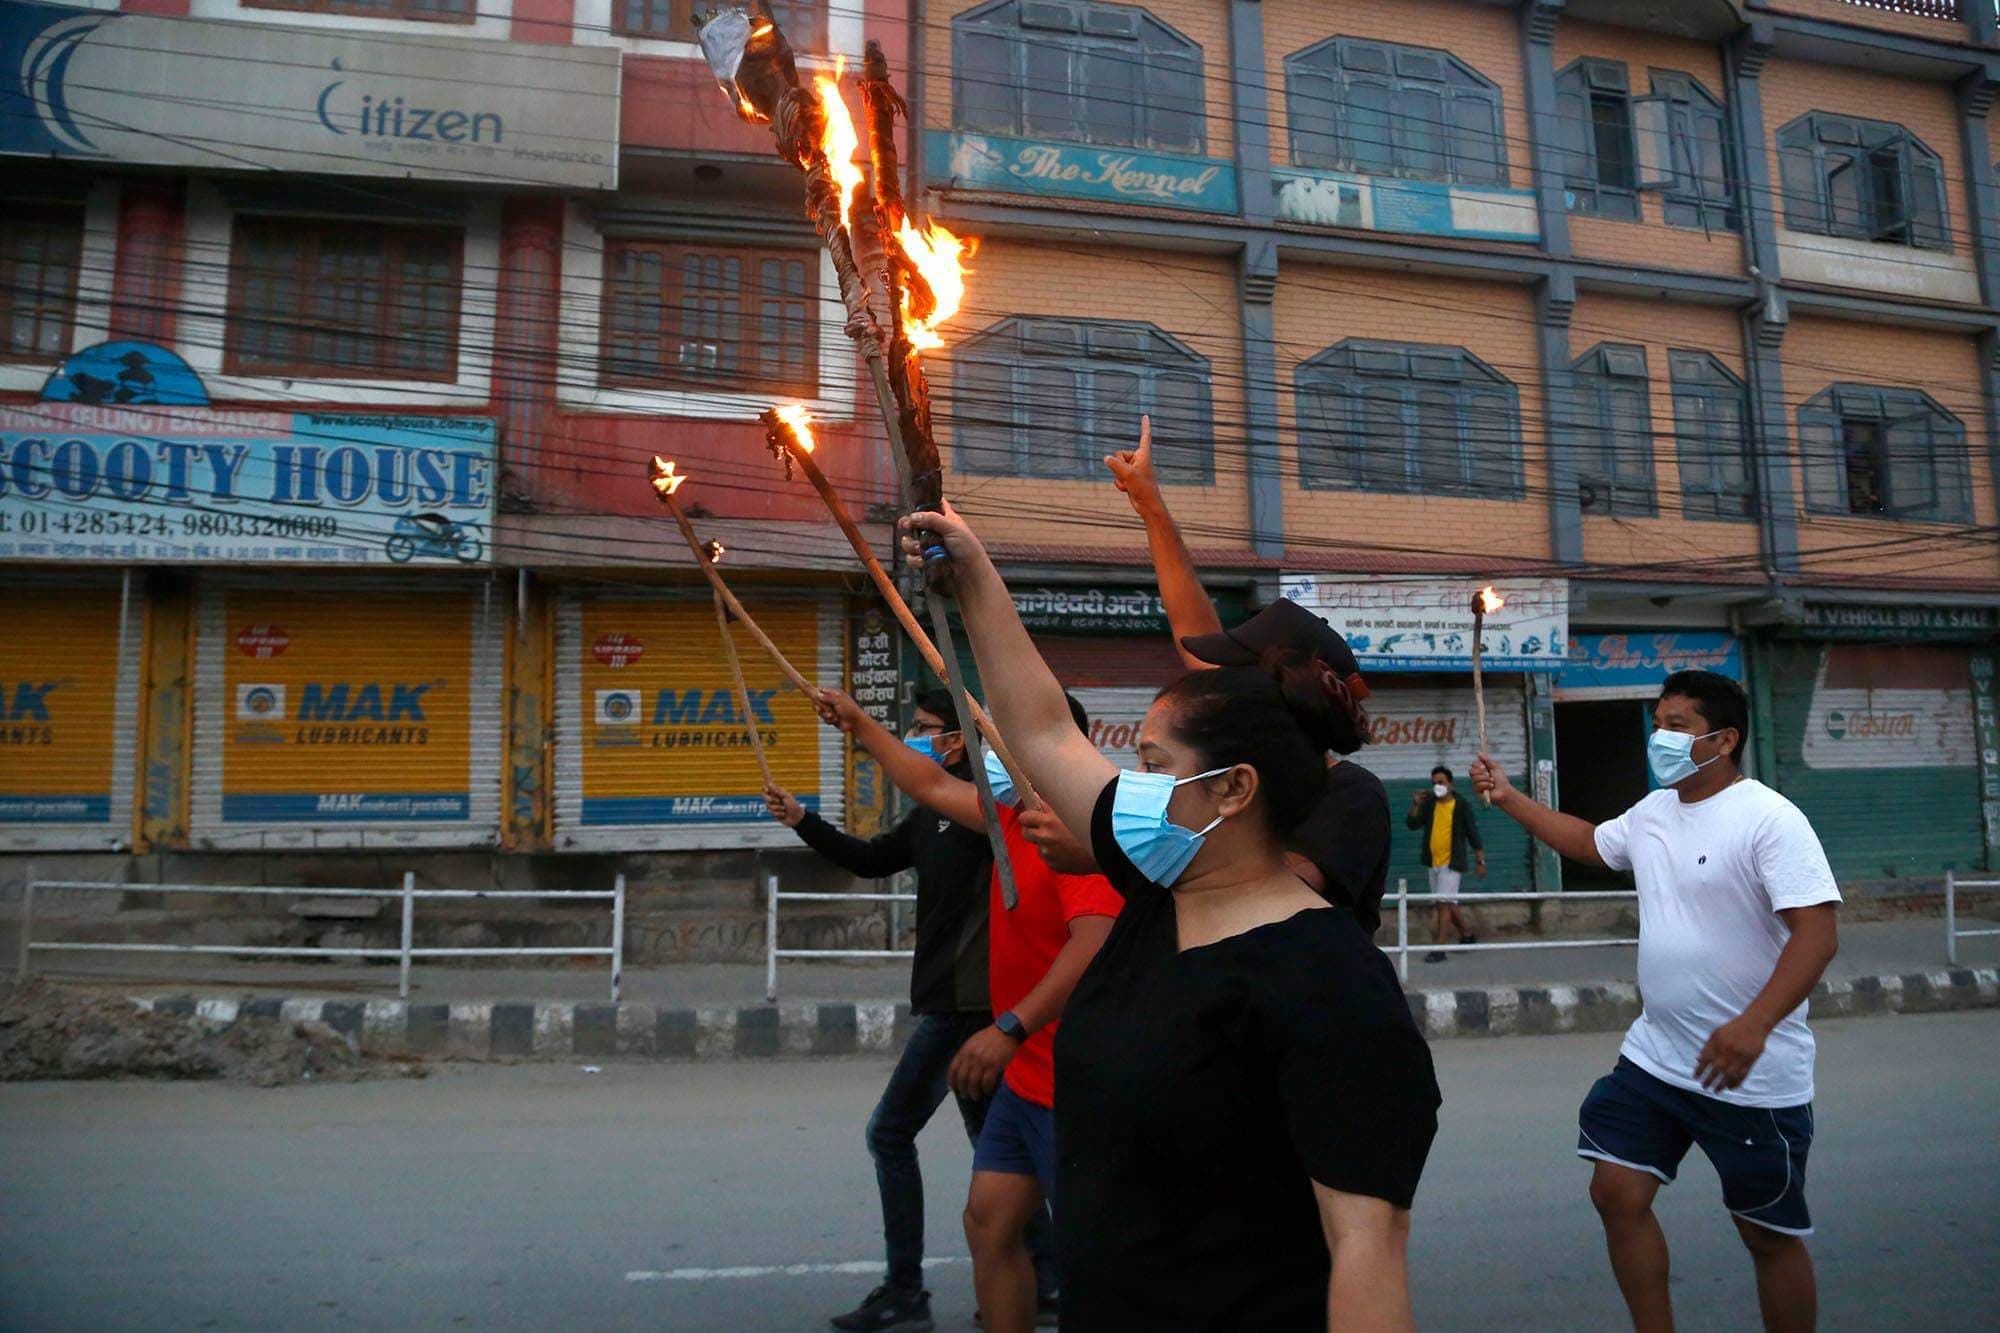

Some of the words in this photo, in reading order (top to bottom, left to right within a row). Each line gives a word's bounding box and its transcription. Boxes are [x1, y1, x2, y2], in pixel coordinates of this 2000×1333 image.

[317, 78, 504, 143] Citizen
[1010, 145, 1080, 181] The
[1082, 154, 1219, 199] Kennel
[71, 406, 154, 432] SELLING
[169, 411, 281, 438] EXCHANGE
[0, 437, 249, 504] COOTY
[272, 446, 490, 509] HOUSE
[1824, 608, 1895, 625] VEHICLE
[1899, 609, 1931, 627] BUY
[1935, 611, 1946, 628] &
[1950, 611, 1990, 629] SALE
[296, 682, 433, 722] MAK
[653, 689, 777, 725] MAK
[294, 728, 431, 745] LUBRICANTS
[1370, 716, 1457, 745] Castrol
[1848, 711, 1916, 738] Castrol
[317, 794, 364, 813] MAK
[672, 797, 714, 815] MAK
